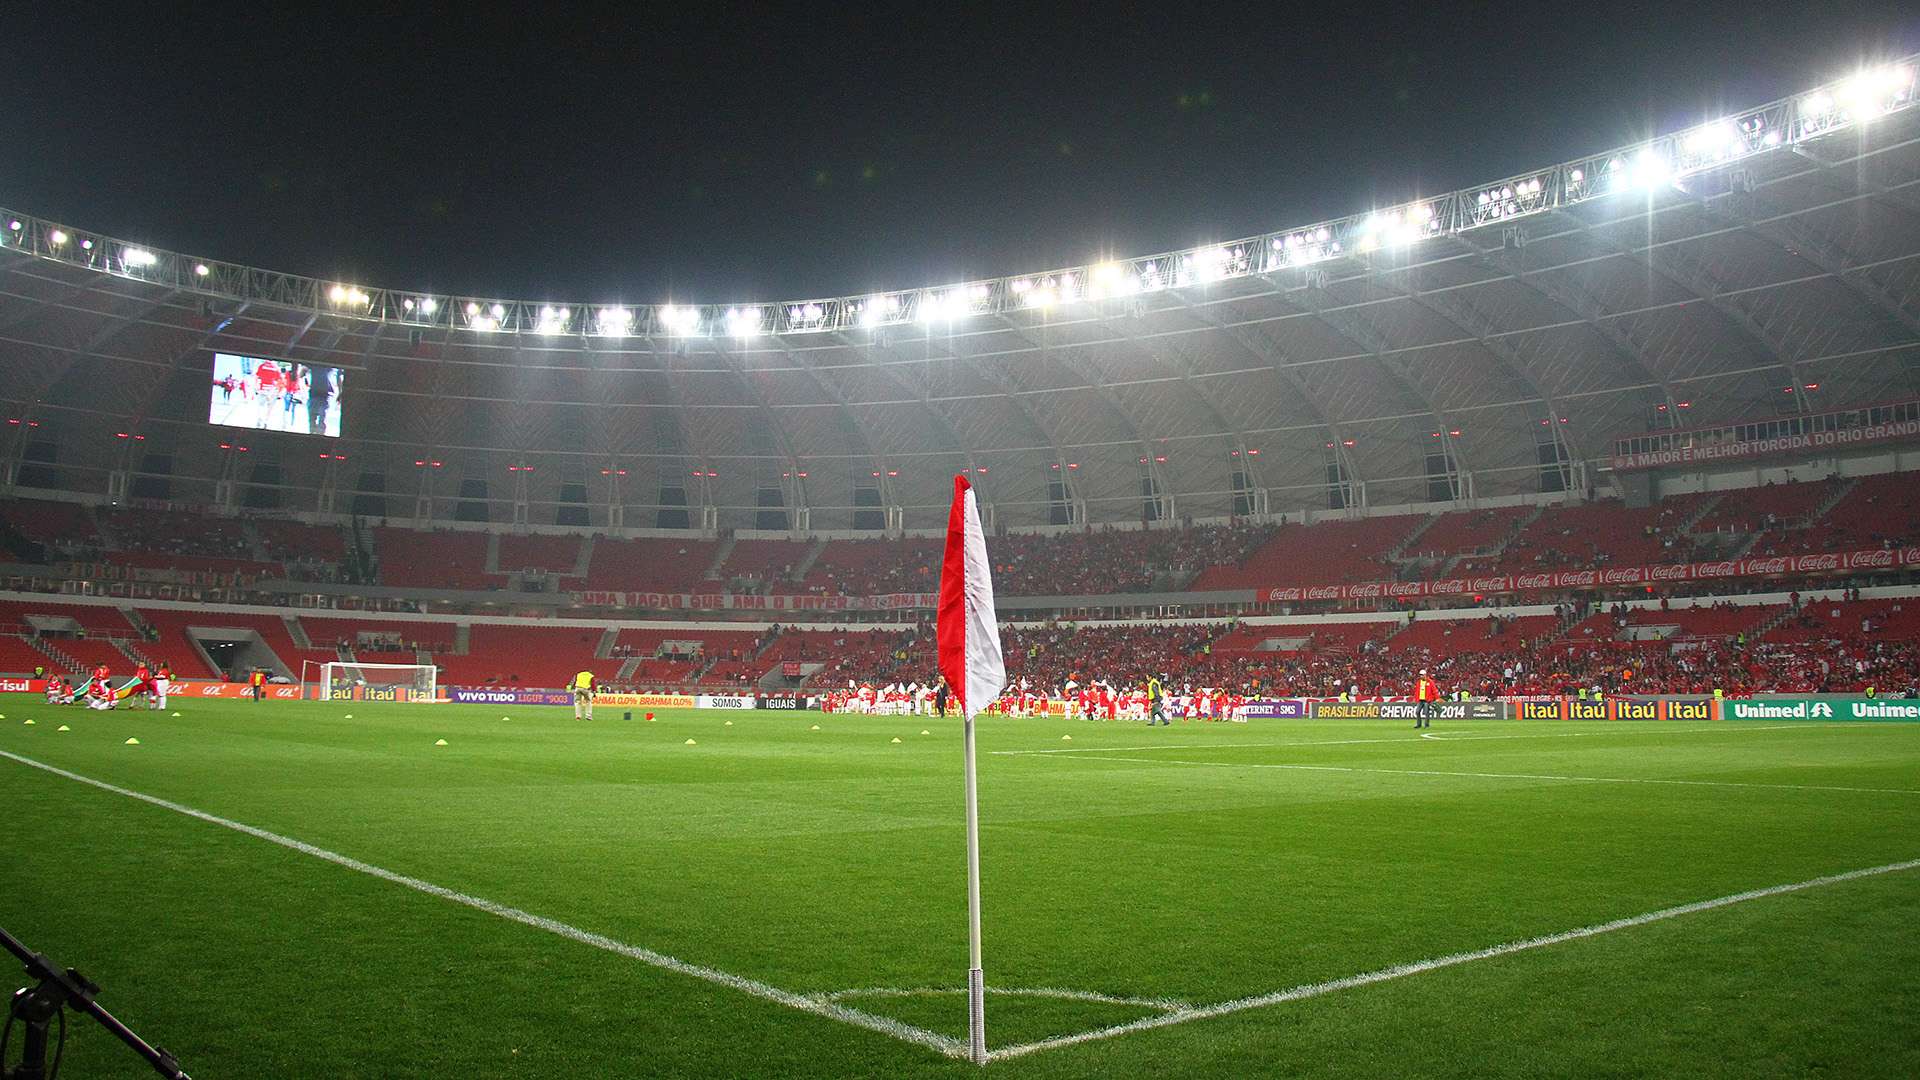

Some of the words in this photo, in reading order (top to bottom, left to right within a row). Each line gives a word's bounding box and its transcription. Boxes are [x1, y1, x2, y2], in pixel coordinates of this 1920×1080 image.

[1638, 451, 1681, 466] MAIOR
[1693, 443, 1750, 460] MELHOR
[1752, 436, 1811, 453] TORCIDA
[1815, 433, 1834, 446] DO
[1837, 429, 1862, 443] RIO
[1865, 422, 1920, 440] GRAND
[458, 692, 486, 701] VIVO
[488, 693, 515, 702] TUDO
[518, 694, 544, 702] LIGUE
[640, 697, 672, 706] BRAHMA
[712, 698, 742, 708] SOMOS
[766, 699, 796, 708] IGUAIS
[1034, 702, 1065, 714] BAHMA
[1246, 705, 1274, 714] TERNET
[1280, 705, 1296, 714] SMS
[1318, 704, 1379, 718] BRASILEIRÃO
[1440, 705, 1466, 718] 2014
[1524, 702, 1558, 718] Itaú
[1570, 702, 1605, 718] Itaú
[1618, 702, 1655, 718] Itaú
[1669, 702, 1707, 718] Itaú
[1734, 702, 1805, 718] Unimed
[1852, 702, 1920, 718] Unime
